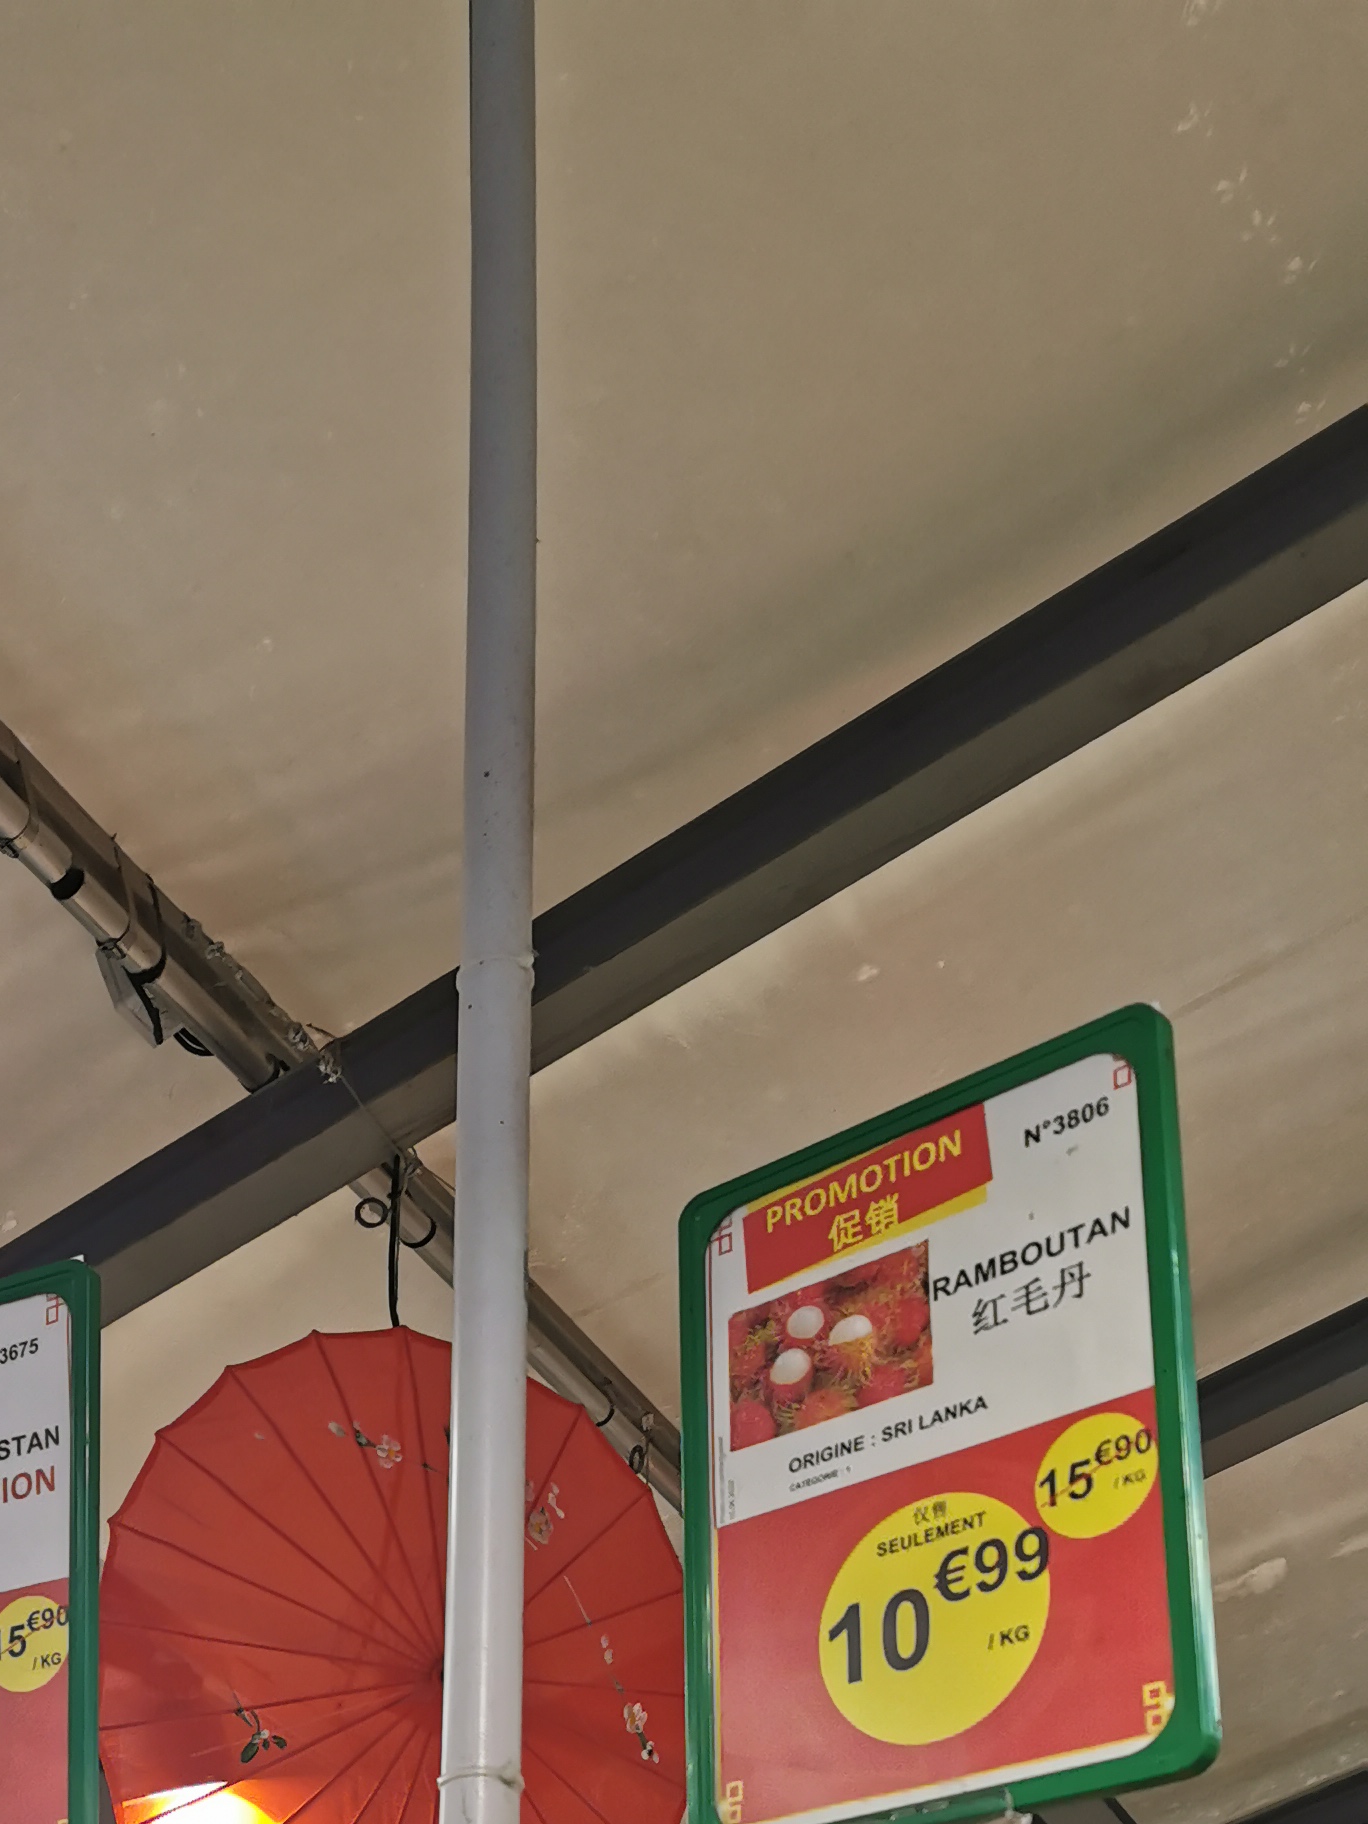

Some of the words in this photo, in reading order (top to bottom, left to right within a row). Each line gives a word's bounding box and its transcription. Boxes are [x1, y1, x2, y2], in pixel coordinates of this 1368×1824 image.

[1023, 1097, 1110, 1149] N°3806
[765, 1129, 962, 1234] PROMOTION
[827, 1192, 900, 1253] 促销
[932, 1205, 1131, 1301] RAMBOUTAN
[972, 1260, 1092, 1336] 红毛丹
[788, 1435, 865, 1474] ORIGINE
[881, 1419, 913, 1443] SRI
[918, 1395, 989, 1430] LANKA
[876, 1510, 988, 1557] SEULEMENT
